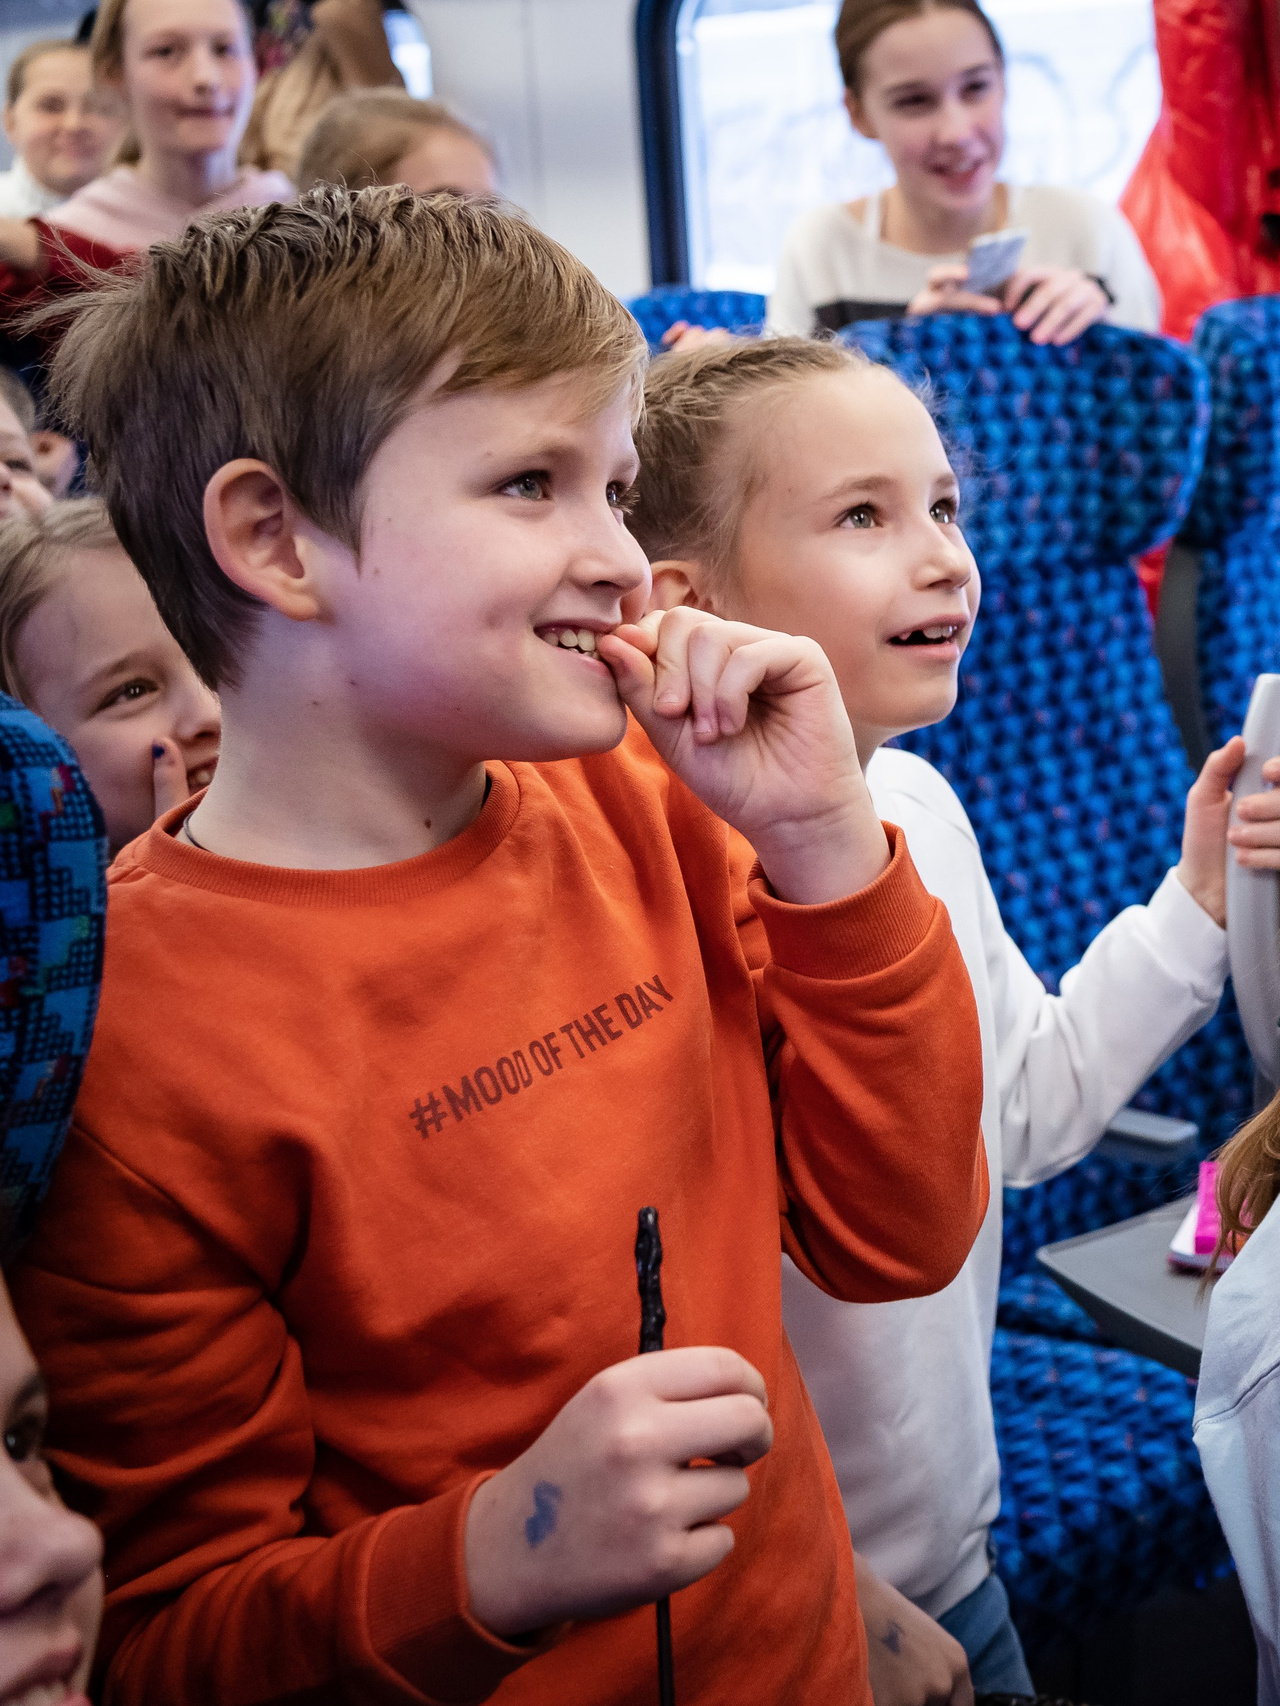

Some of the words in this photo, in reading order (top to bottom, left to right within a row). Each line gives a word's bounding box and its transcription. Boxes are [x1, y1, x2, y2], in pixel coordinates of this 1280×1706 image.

[408, 1049, 534, 1140] #MOOD
[528, 1031, 564, 1077] OF
[559, 1003, 623, 1059] THE
[614, 974, 674, 1031] DAY
